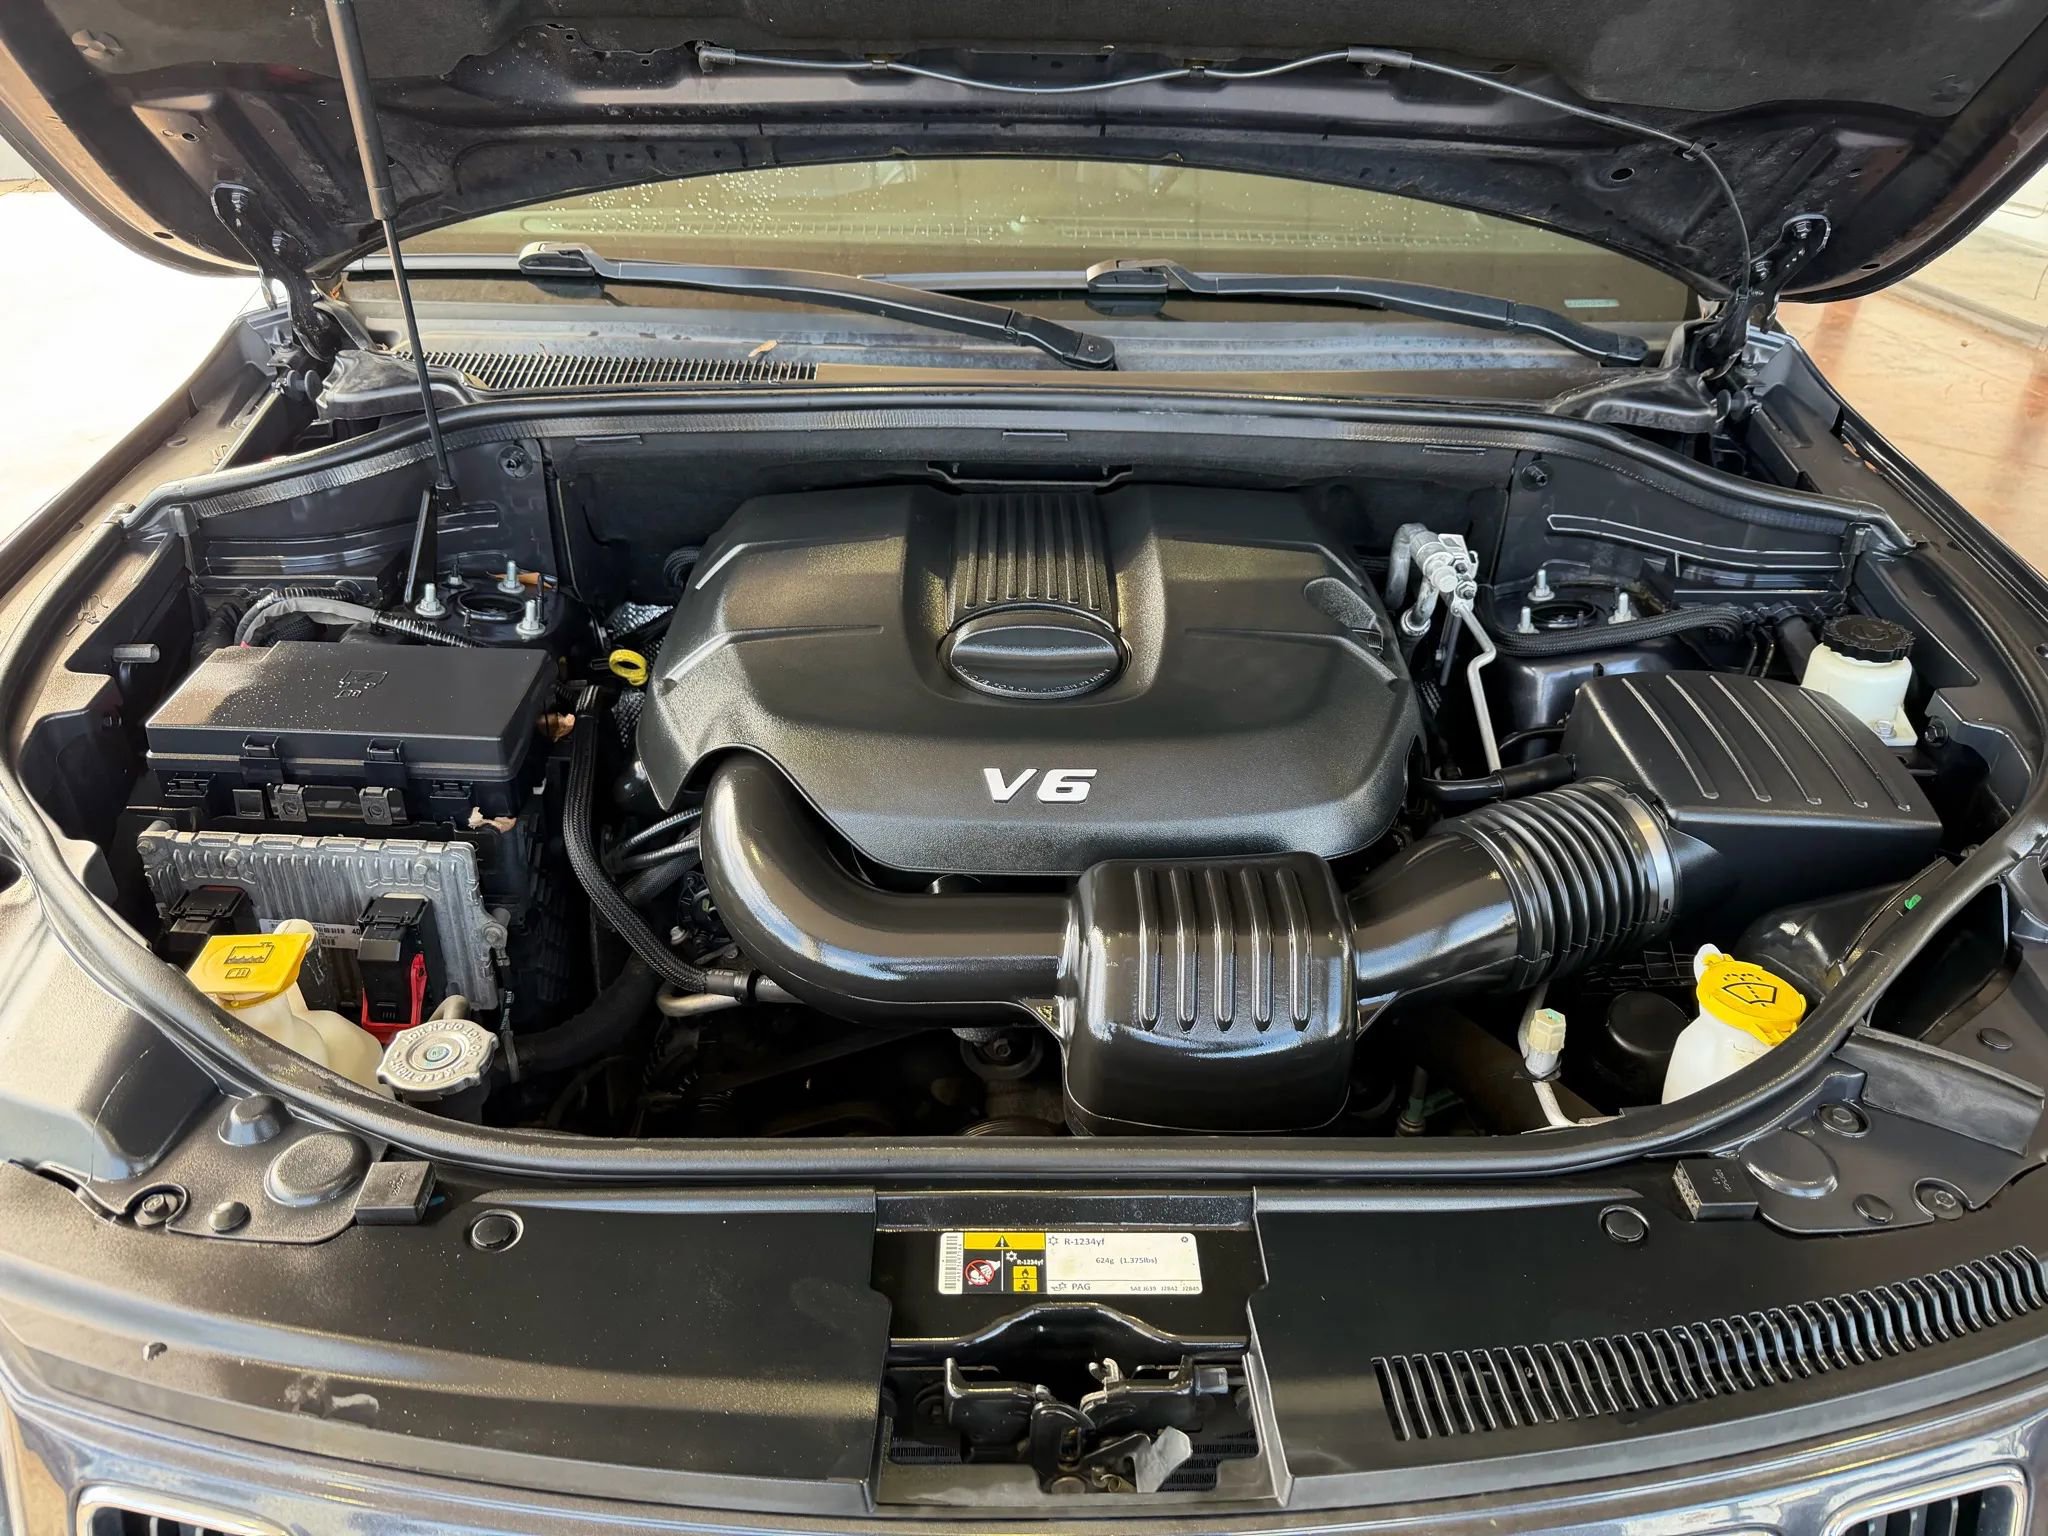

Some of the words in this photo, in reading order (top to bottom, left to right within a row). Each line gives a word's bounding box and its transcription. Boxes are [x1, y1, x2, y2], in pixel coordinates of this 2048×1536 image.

[984, 768, 1098, 804] V6
[1064, 1237, 1105, 1247] R-1234yf
[1095, 1256, 1115, 1264] 624g
[1119, 1256, 1158, 1265] (1.375lbs)
[1071, 1282, 1091, 1291] PAG
